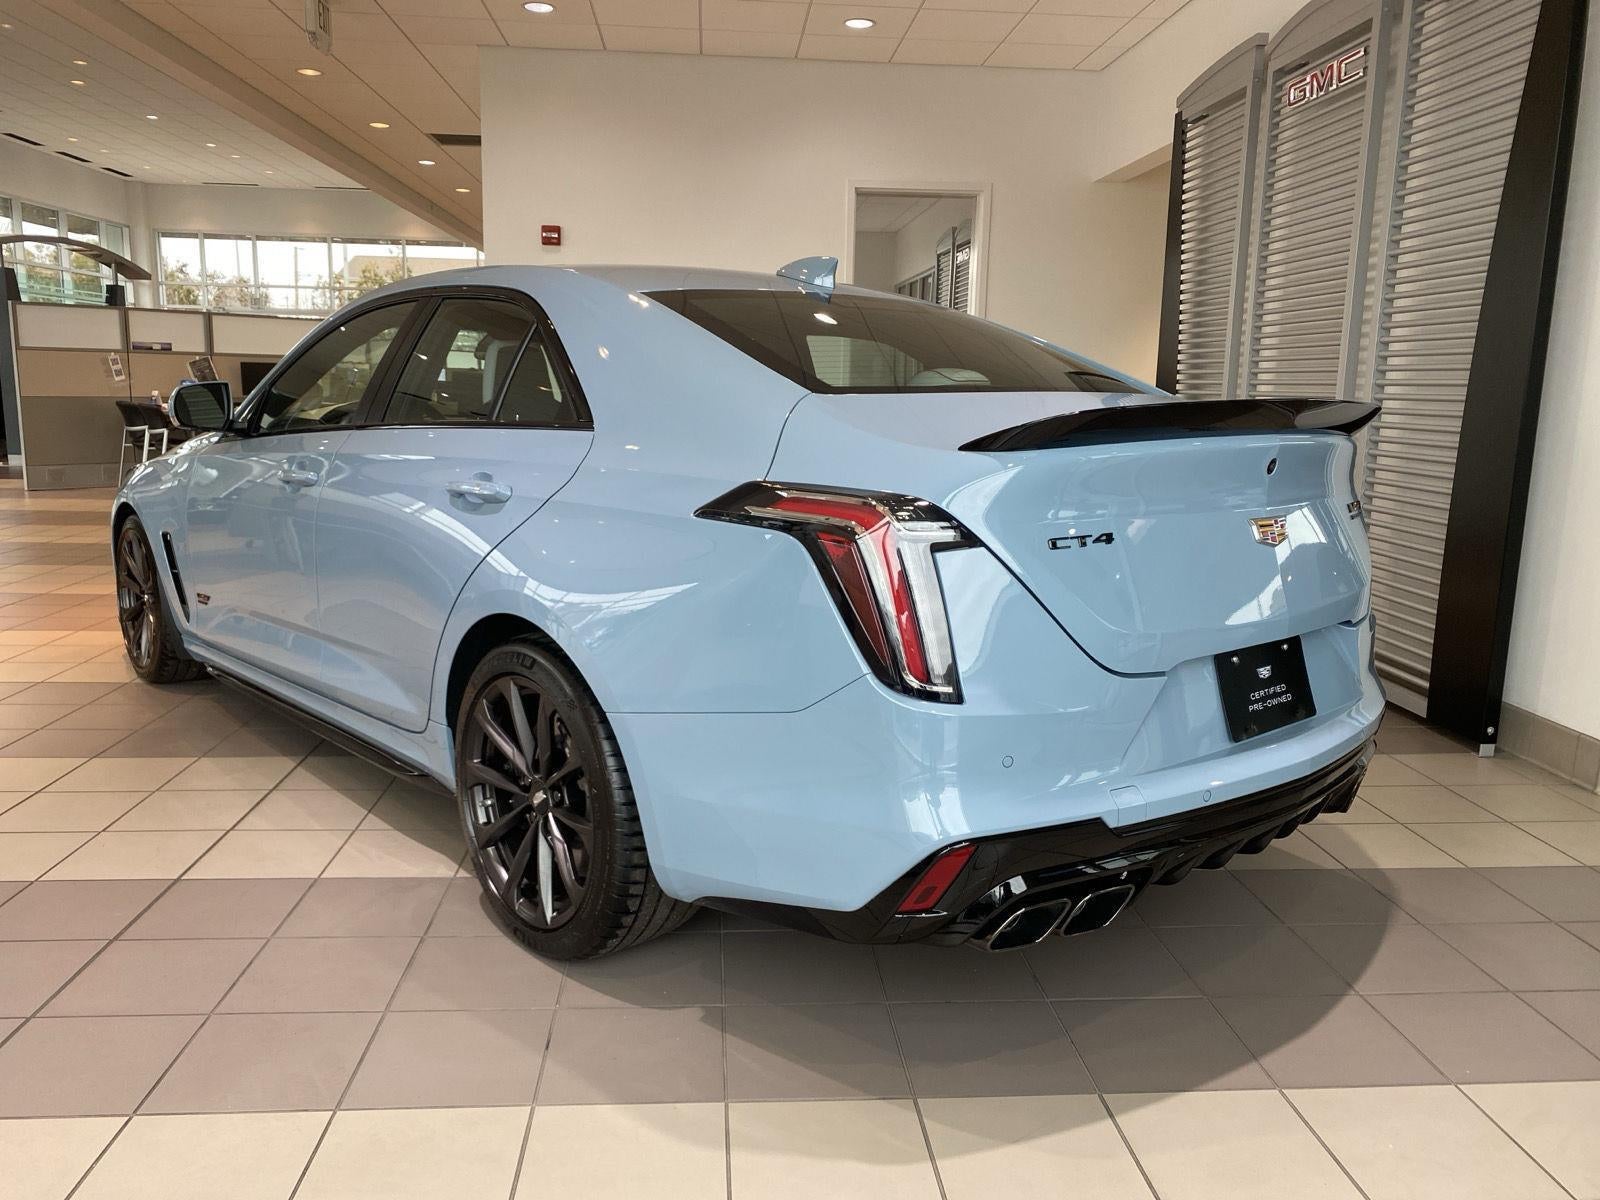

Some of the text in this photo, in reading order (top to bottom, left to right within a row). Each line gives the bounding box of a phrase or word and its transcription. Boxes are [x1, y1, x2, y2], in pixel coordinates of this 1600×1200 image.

[1286, 46, 1365, 108] GMC
[1048, 532, 1115, 550] CT4
[1250, 683, 1287, 700] CERTIFIED
[1248, 693, 1292, 713] PRE-OWNED
